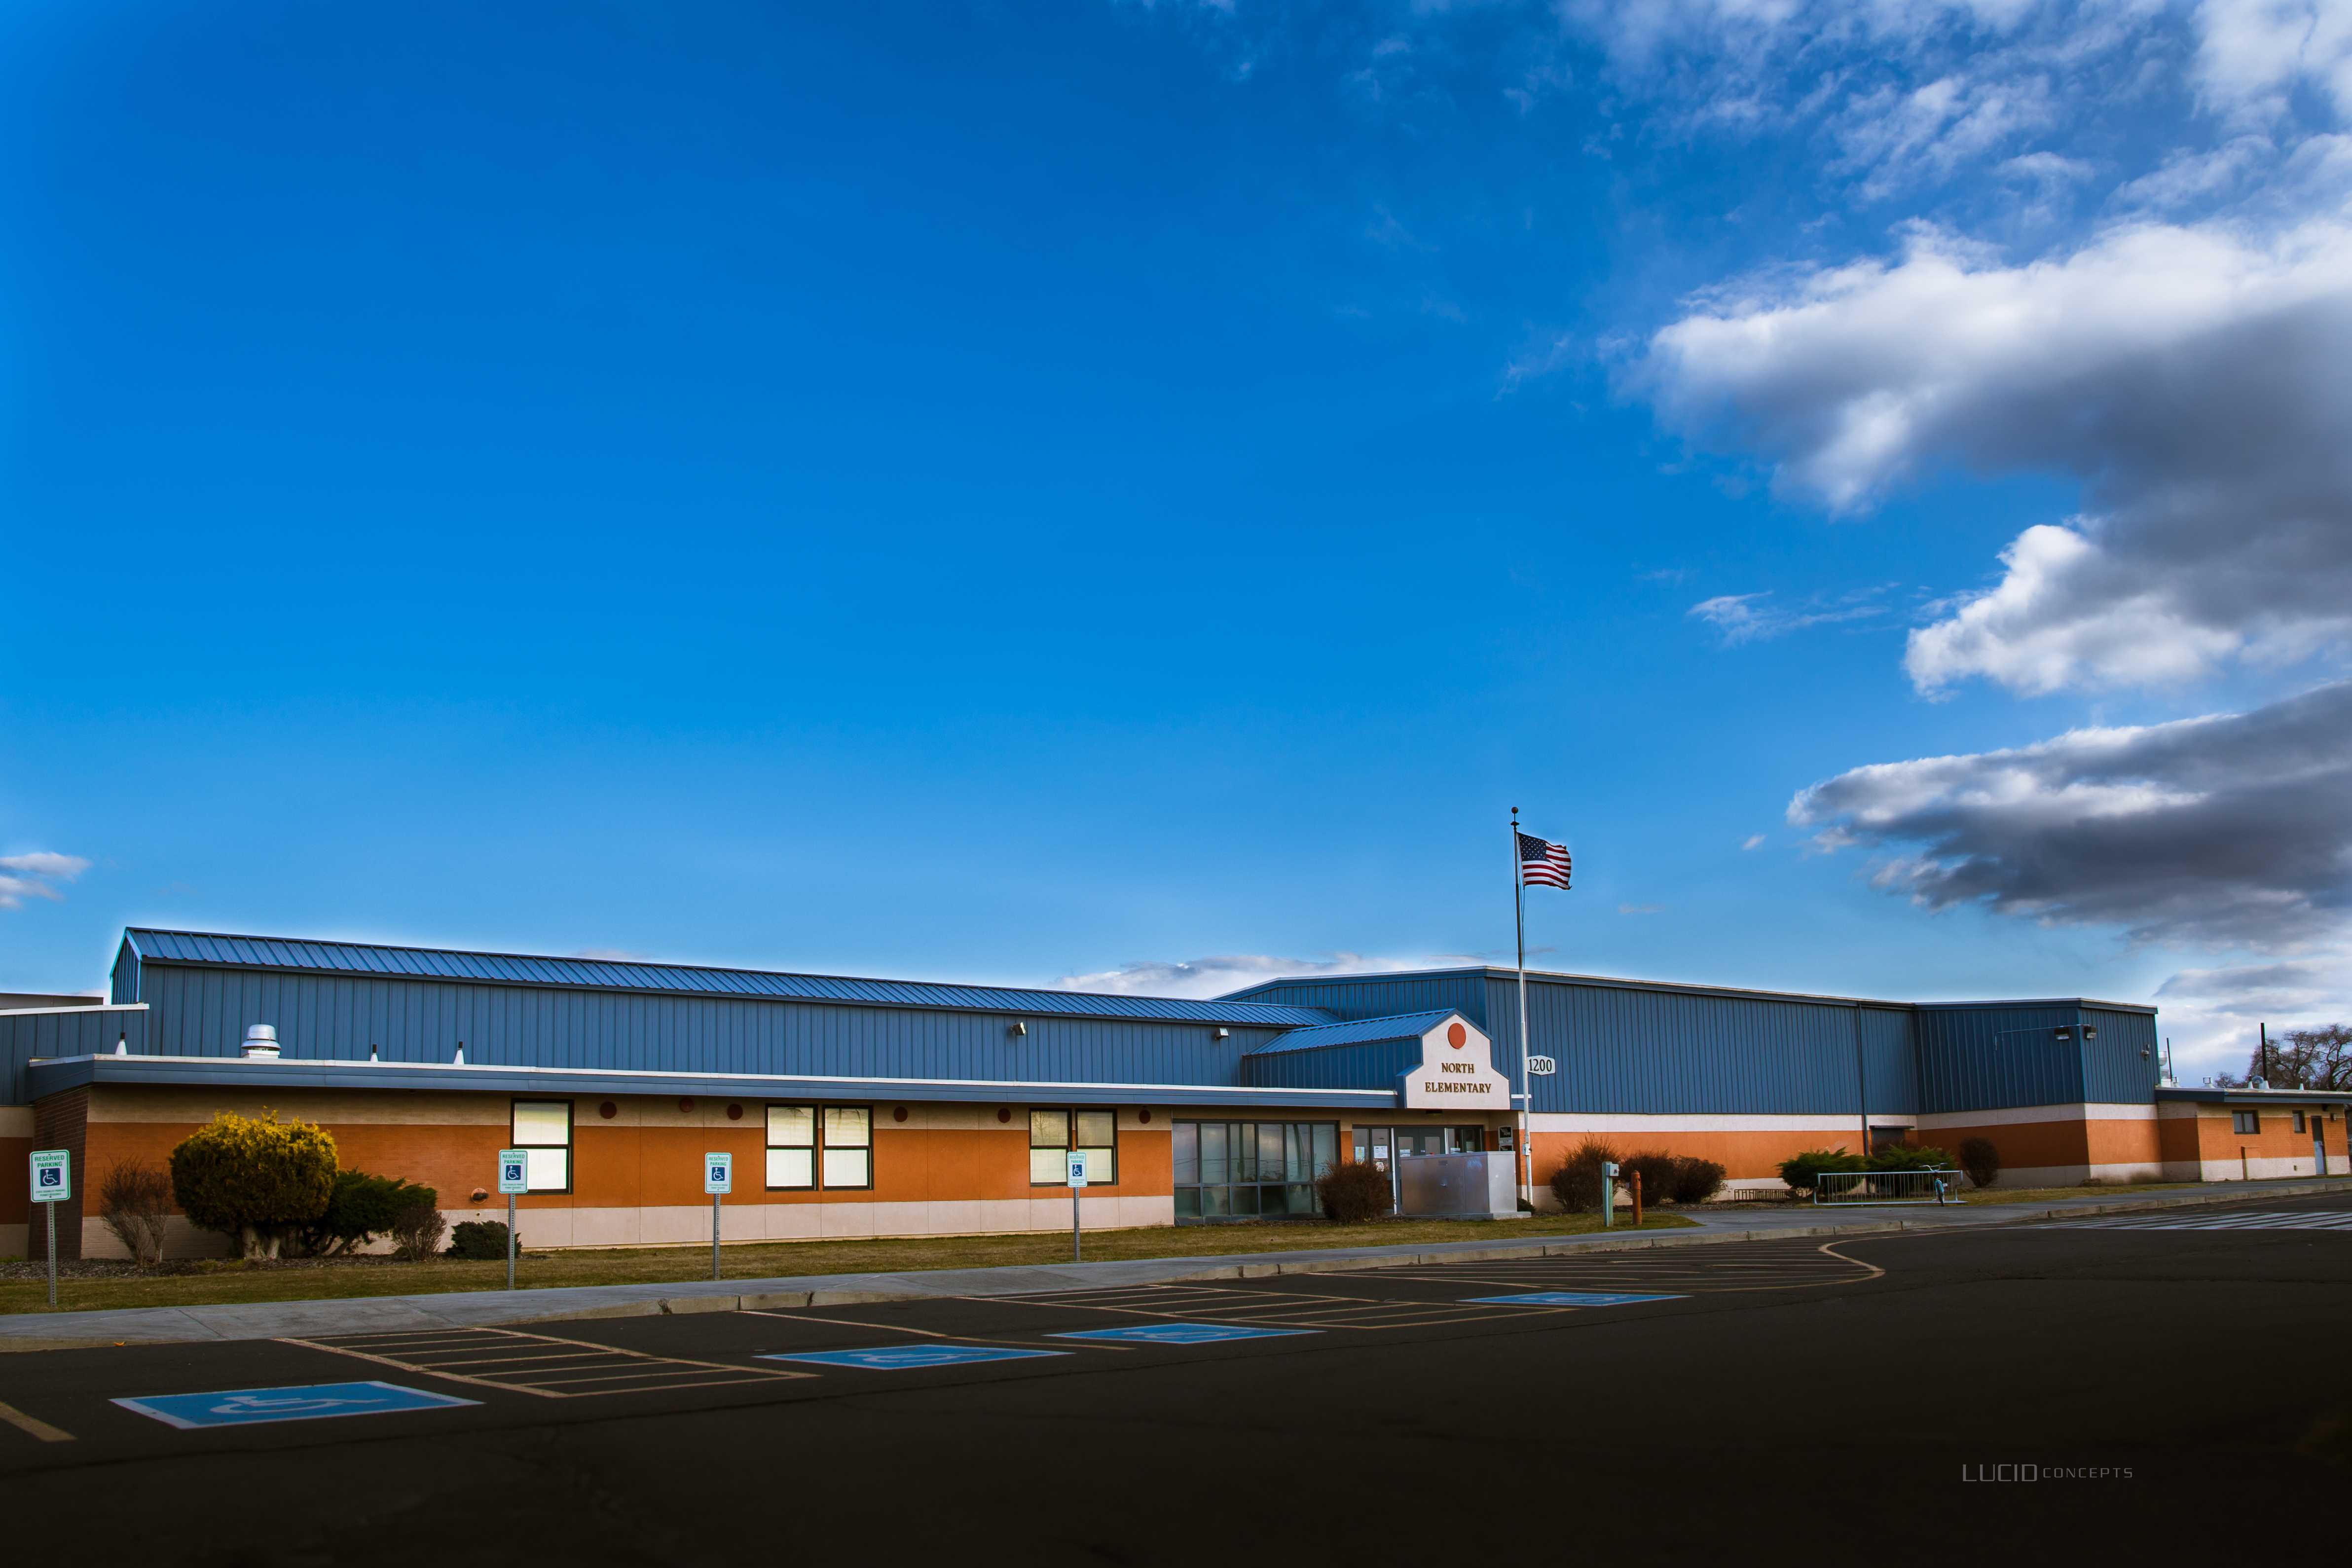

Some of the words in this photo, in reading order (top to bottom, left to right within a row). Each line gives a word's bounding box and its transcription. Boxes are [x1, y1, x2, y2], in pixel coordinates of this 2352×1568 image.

[1441, 1062, 1475, 1073] NORTH
[1529, 1058, 1552, 1072] 1200
[1425, 1082, 1492, 1093] ELEMENTARY
